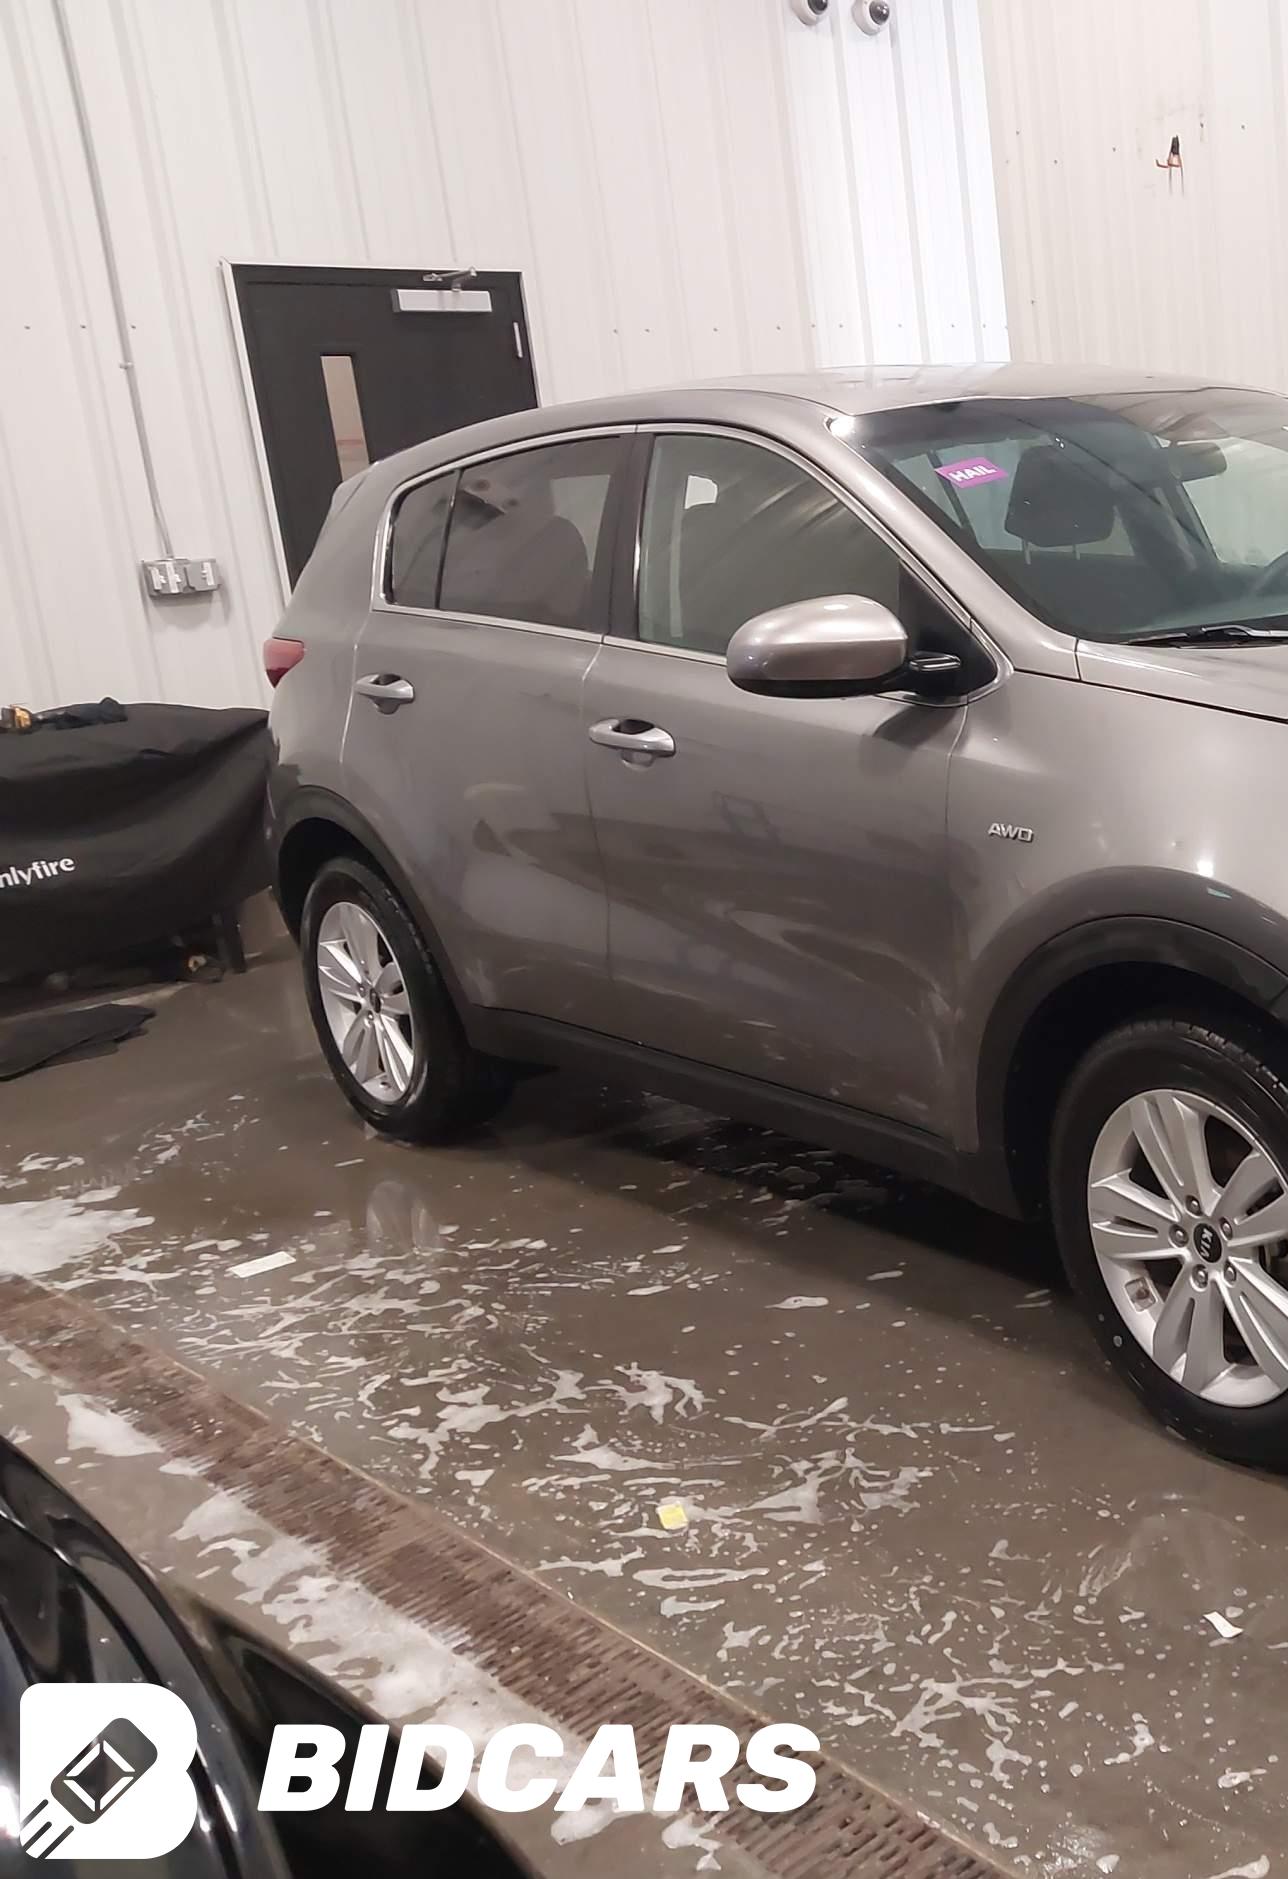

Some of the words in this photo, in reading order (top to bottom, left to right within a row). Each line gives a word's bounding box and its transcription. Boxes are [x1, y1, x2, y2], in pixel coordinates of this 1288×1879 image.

[948, 465, 997, 482] HAIL
[988, 822, 1033, 842] AWD
[1200, 1228, 1213, 1257] KIA
